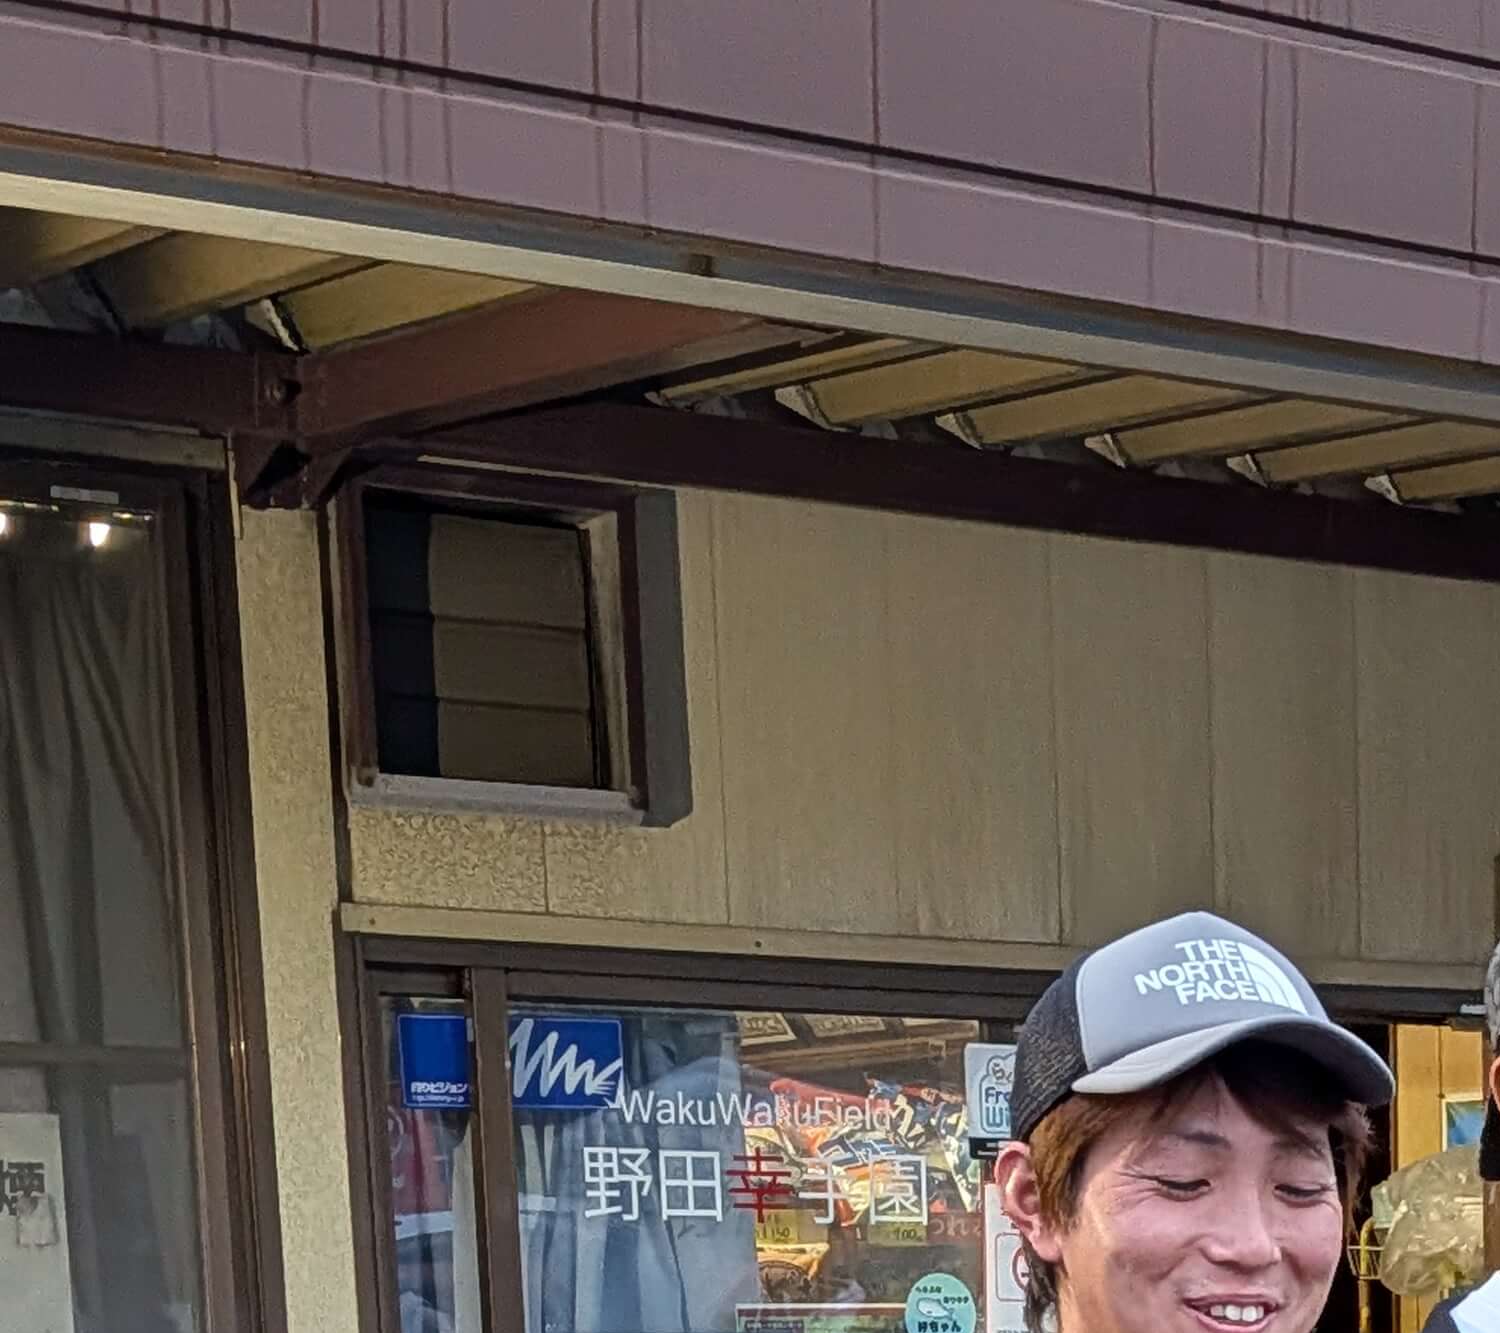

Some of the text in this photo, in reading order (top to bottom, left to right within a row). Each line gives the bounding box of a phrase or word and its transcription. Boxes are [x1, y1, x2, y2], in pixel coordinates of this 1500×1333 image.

[1175, 938, 1242, 962] THE
[1134, 959, 1251, 996] NORTH
[1177, 979, 1259, 1006] FACE
[620, 1089, 891, 1132] WakuWakuField
[583, 1147, 929, 1225] 野田幸手園
